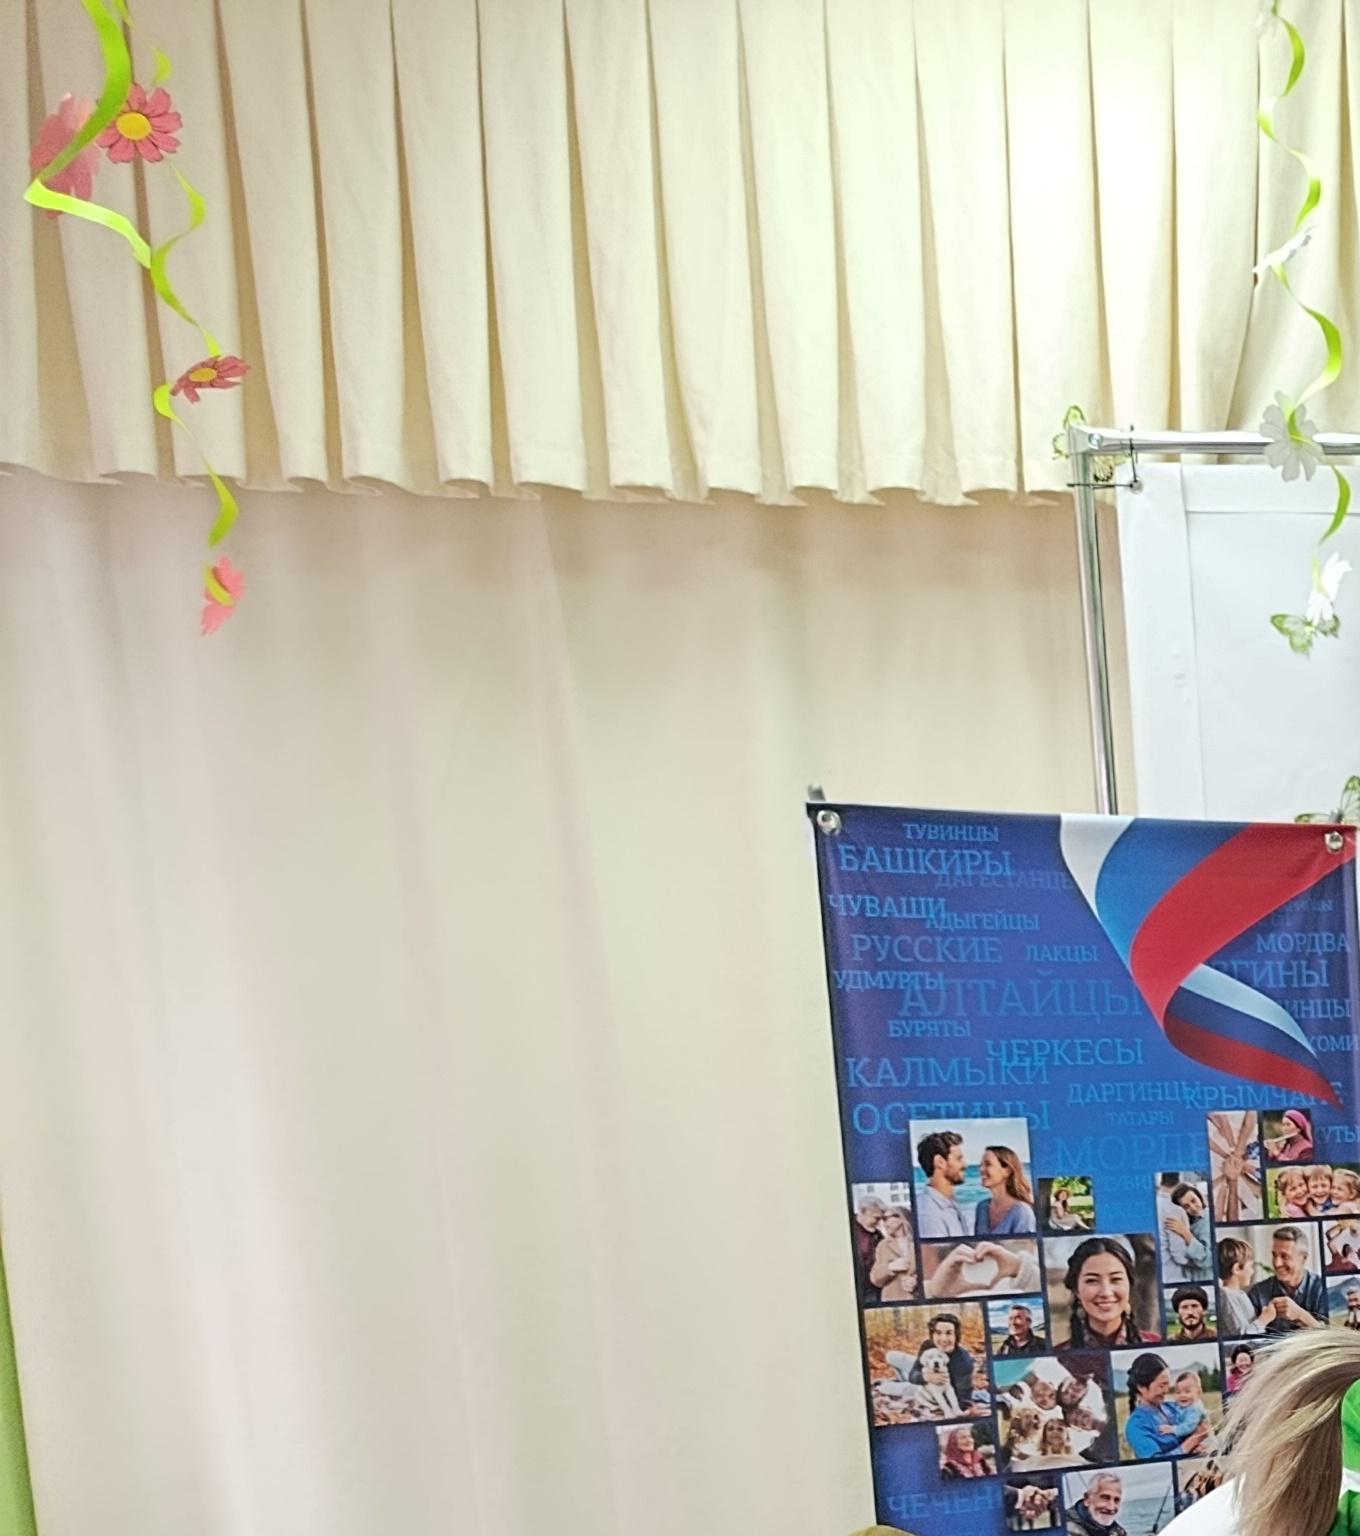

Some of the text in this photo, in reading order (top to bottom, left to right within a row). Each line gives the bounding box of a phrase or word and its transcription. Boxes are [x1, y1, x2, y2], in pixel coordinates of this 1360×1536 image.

[902, 822, 999, 843] ТУВИНЦЫ
[837, 844, 1012, 876] БАШКИРЫ
[828, 893, 946, 919] ЧУВАШИ
[926, 909, 1040, 932] АДЫГЕЙЦЫ
[850, 933, 1003, 963] РУССКИЕ
[1025, 944, 1098, 964] ЛАКЦЫ
[832, 969, 946, 990] УДМУРТЫ
[898, 968, 1143, 1024] АЛТАЙЦЫ
[887, 1019, 972, 1038] БУРЯТЫ
[985, 1038, 1144, 1066] ЧЕРКЕСЫ
[845, 1057, 1050, 1088] КАЛМЫКИ
[1107, 1110, 1174, 1127] ТАТАРЫ
